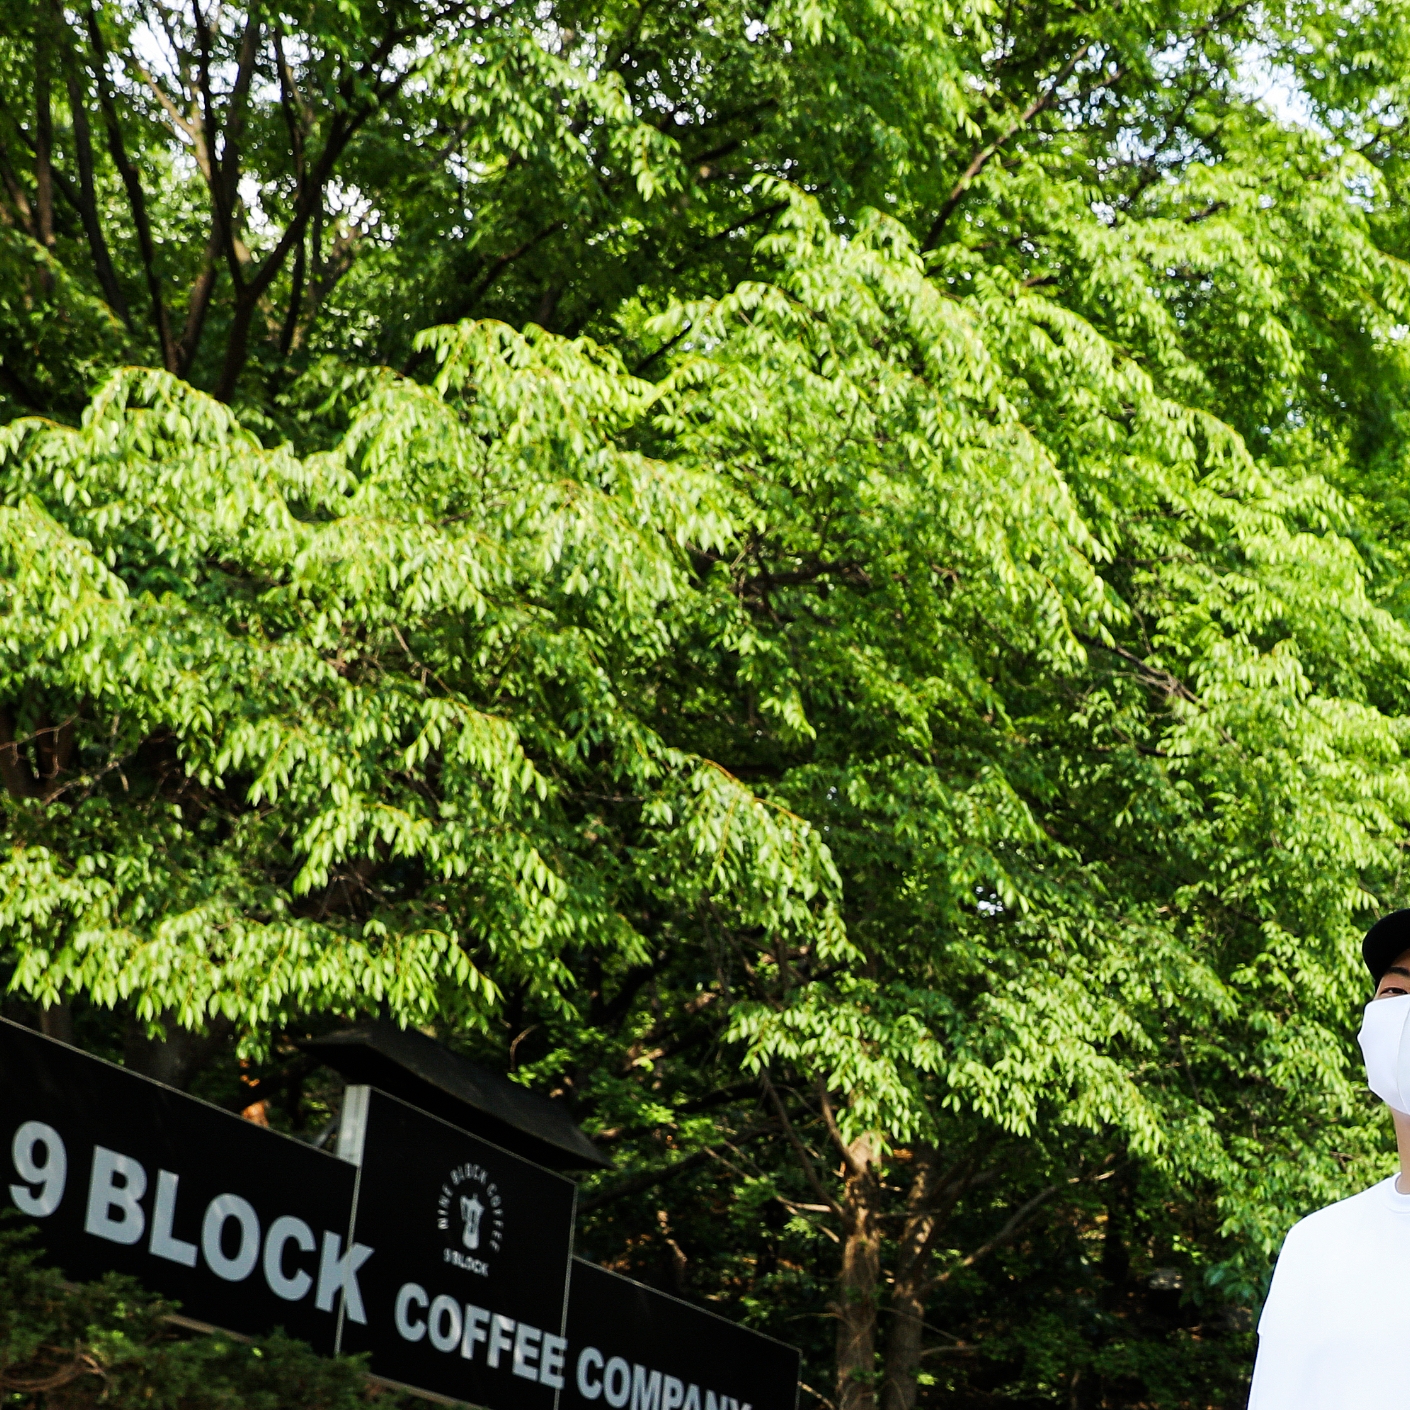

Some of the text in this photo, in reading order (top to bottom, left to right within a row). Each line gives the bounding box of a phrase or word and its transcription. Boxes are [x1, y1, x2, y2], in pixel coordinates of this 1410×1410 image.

[9, 1120, 67, 1218] 9
[84, 1144, 375, 1325] BLOCK
[394, 1282, 568, 1389] COFFEE
